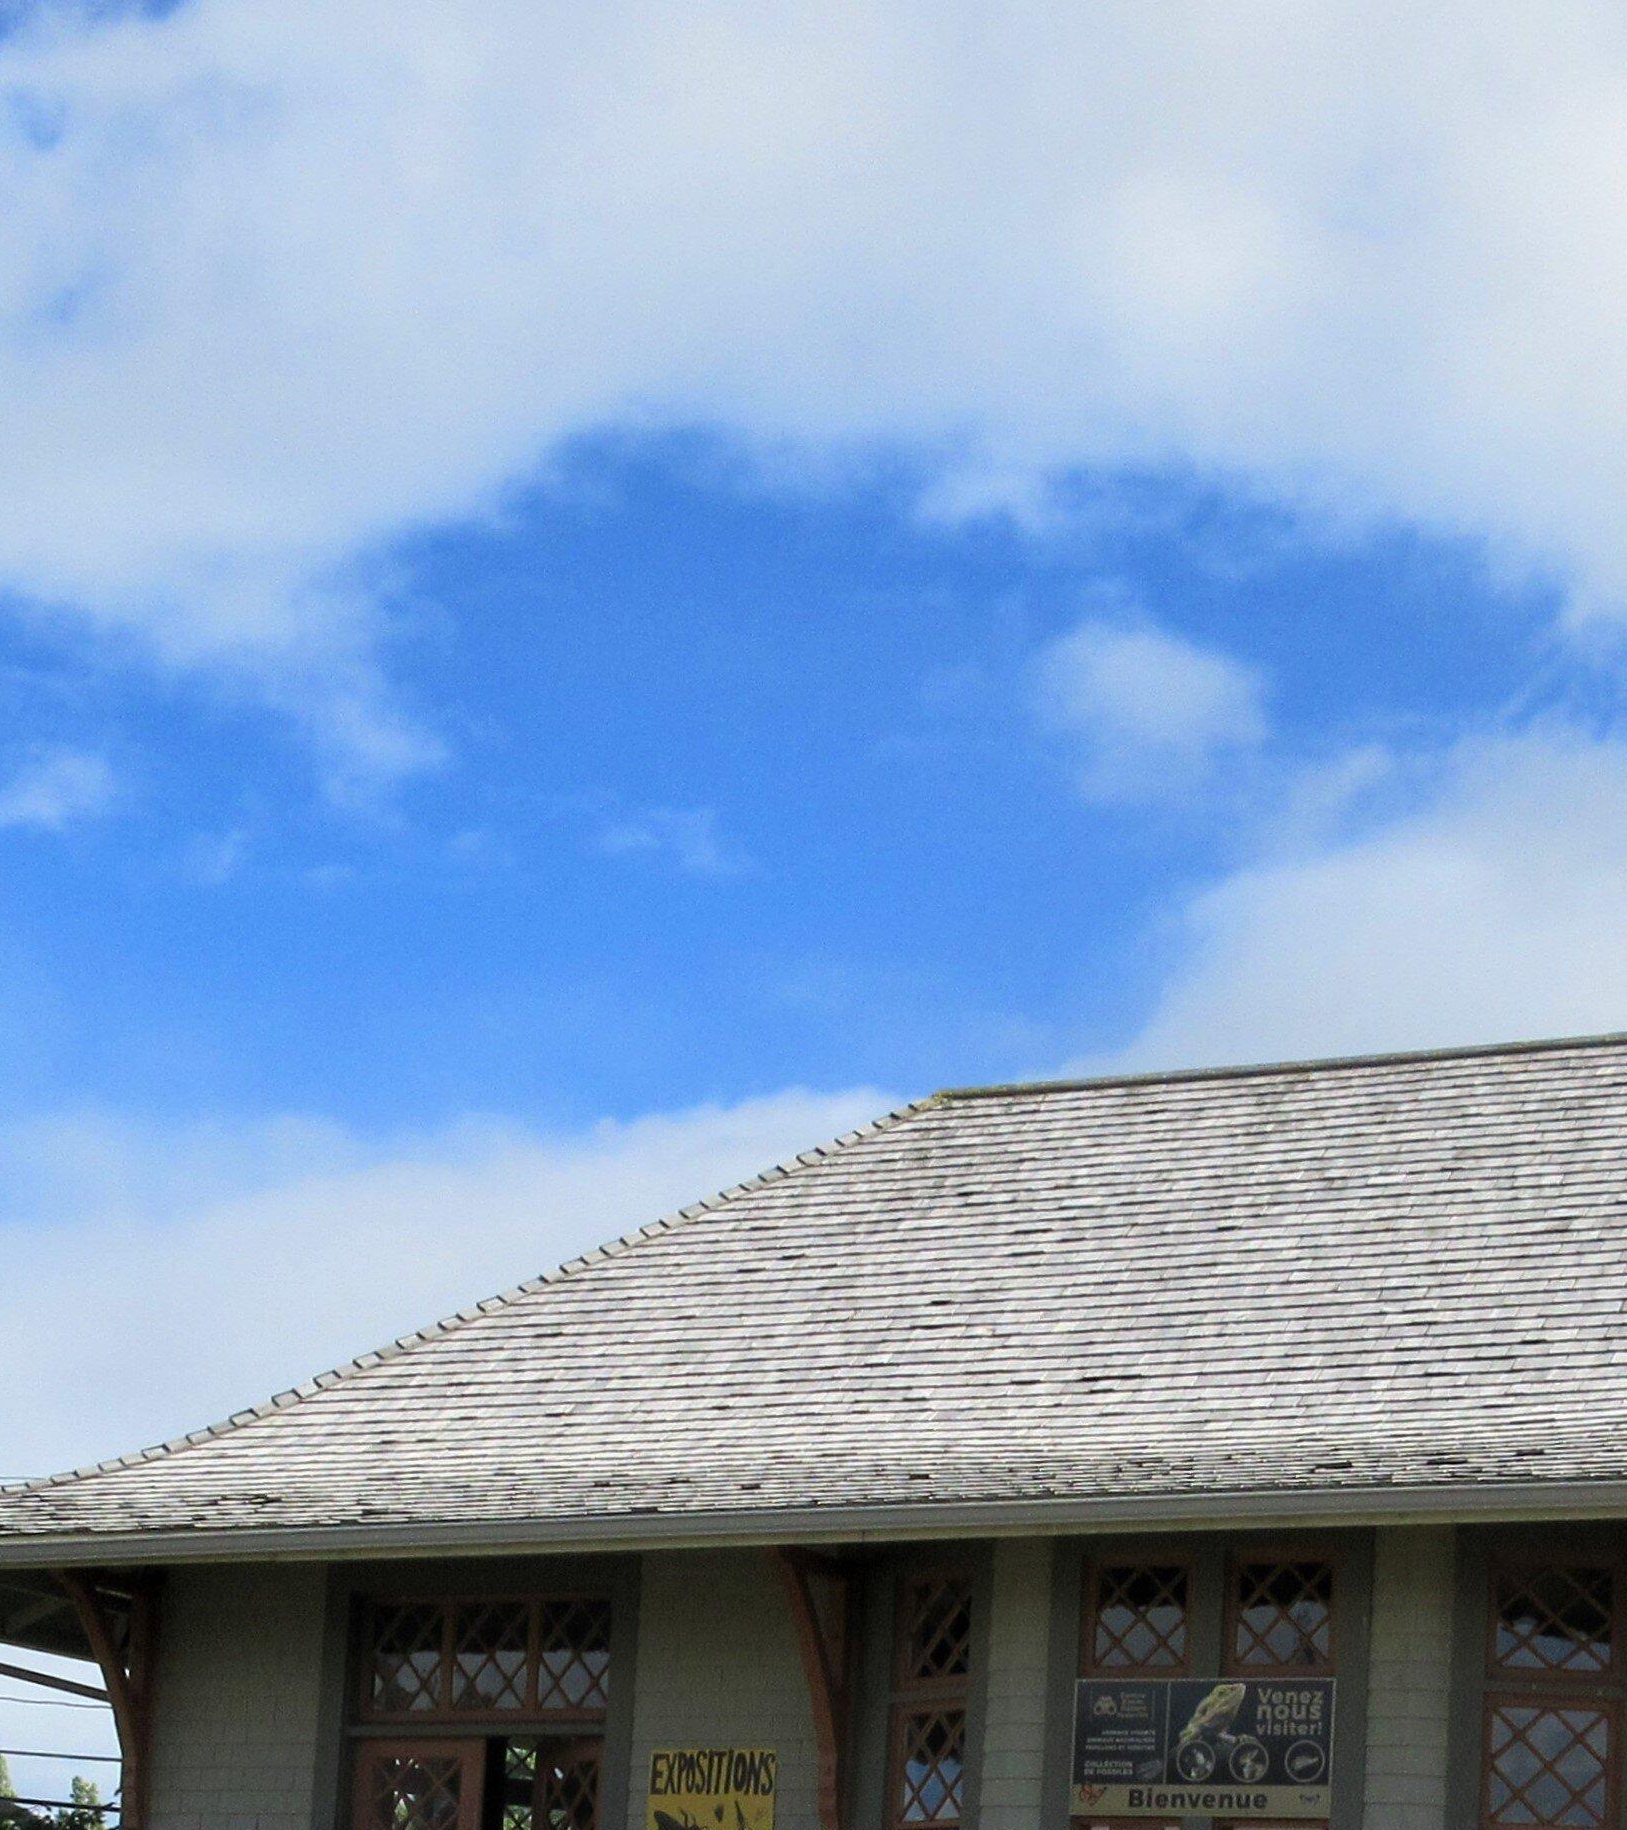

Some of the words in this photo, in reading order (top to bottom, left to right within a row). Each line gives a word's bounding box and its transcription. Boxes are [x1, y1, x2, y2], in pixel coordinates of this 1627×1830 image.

[1257, 1687, 1323, 1705] Venez
[1256, 1704, 1322, 1720] nous
[650, 1749, 776, 1795] EXPOSITIONS
[1129, 1787, 1268, 1809] Bienvenue
